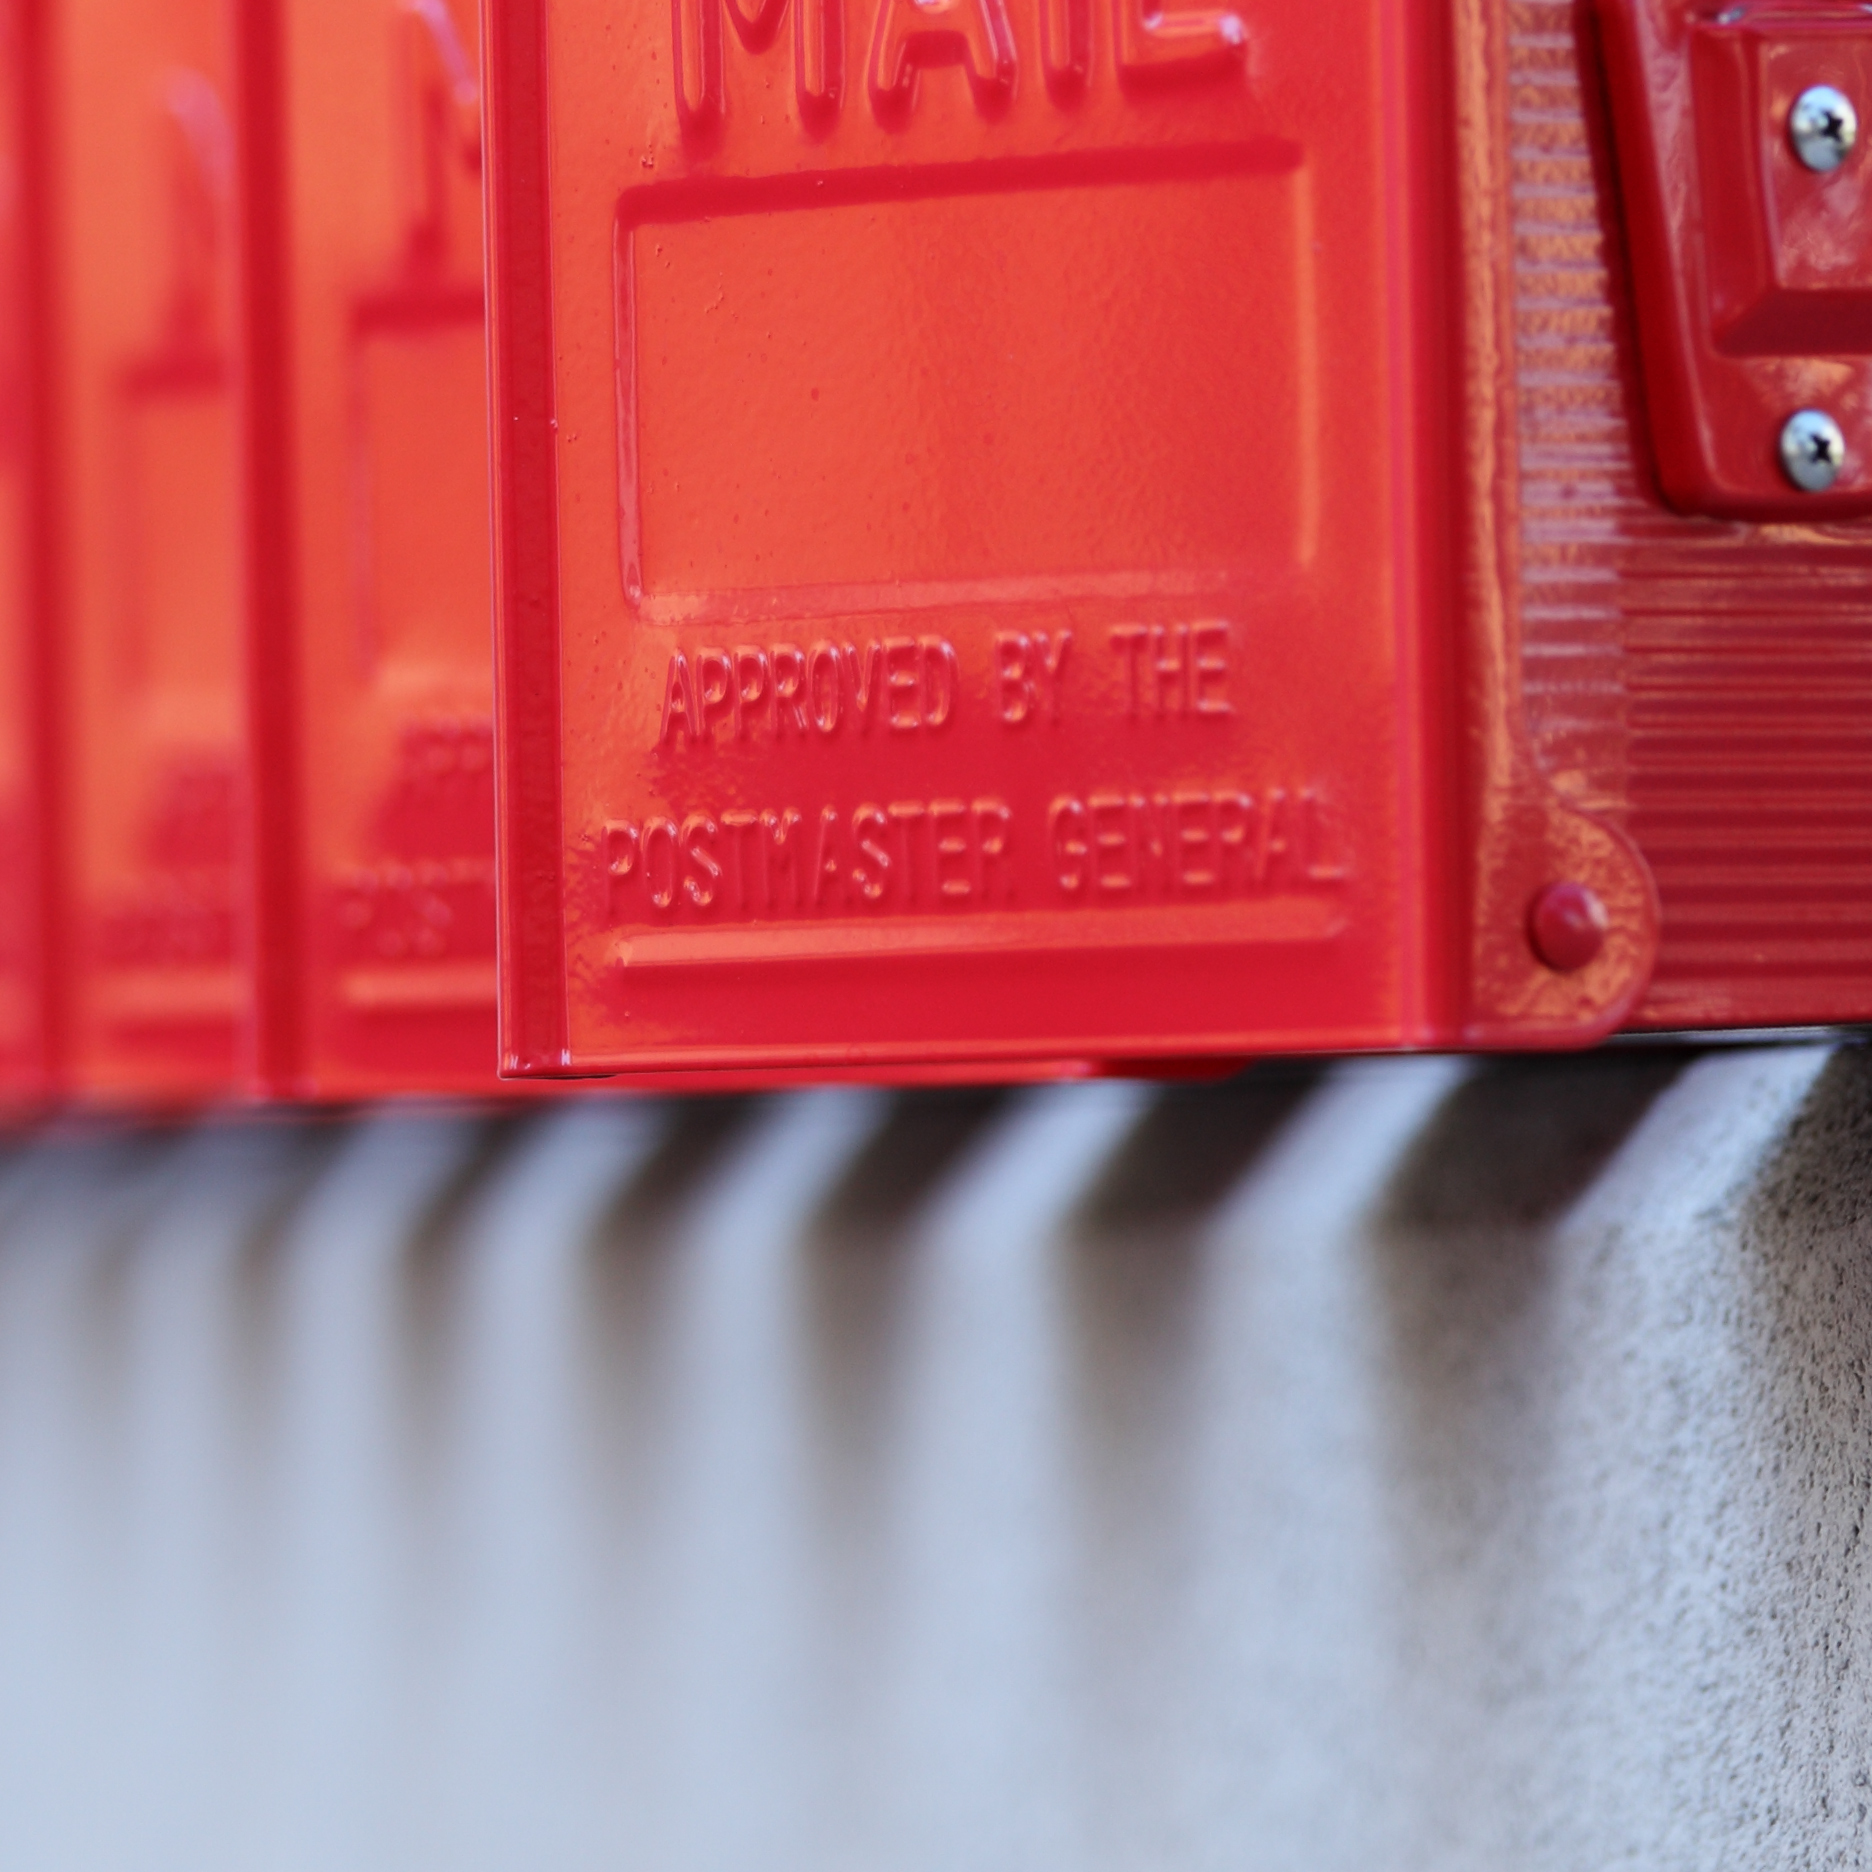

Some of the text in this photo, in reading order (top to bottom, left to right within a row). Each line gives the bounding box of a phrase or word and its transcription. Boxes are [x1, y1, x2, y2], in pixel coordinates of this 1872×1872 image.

[658, 619, 1234, 744] APPROVED BY THE
[601, 802, 1012, 912] POSTMASTER
[1048, 786, 1350, 894] GENERAL
